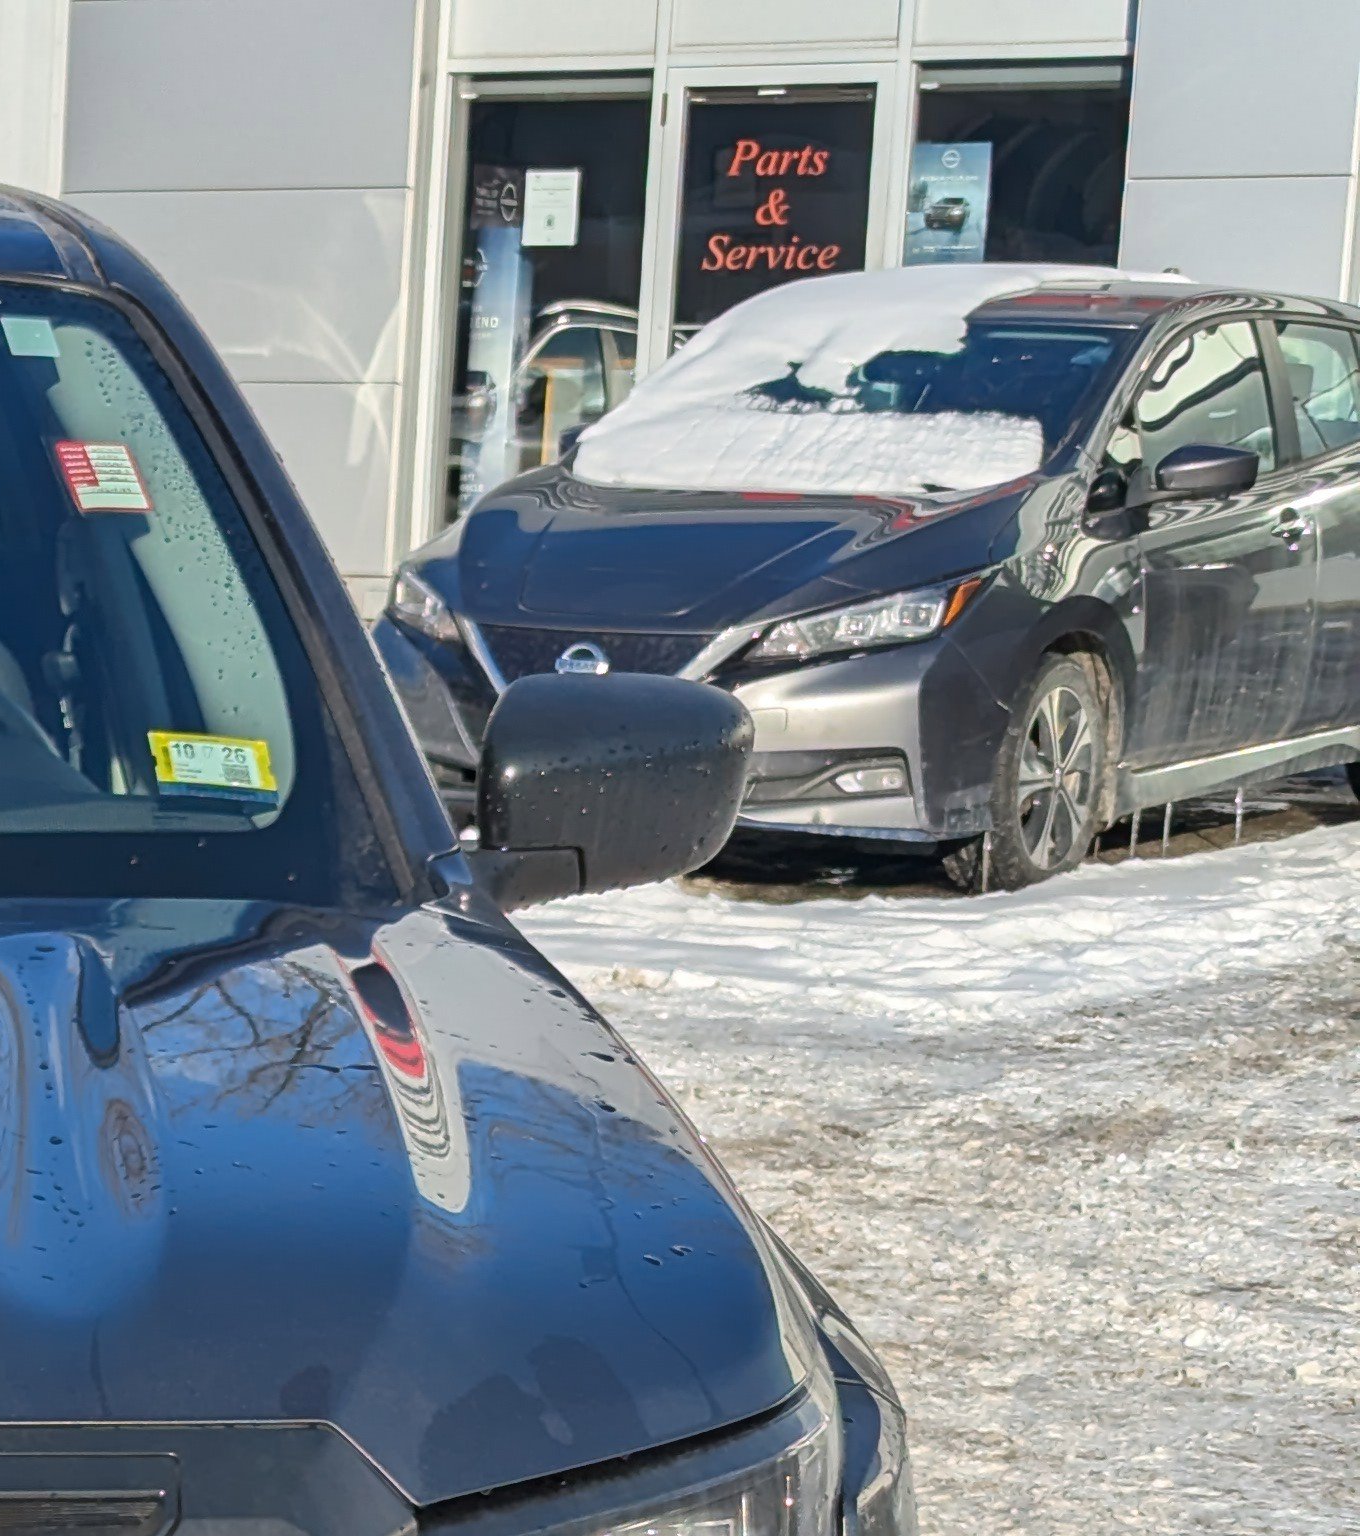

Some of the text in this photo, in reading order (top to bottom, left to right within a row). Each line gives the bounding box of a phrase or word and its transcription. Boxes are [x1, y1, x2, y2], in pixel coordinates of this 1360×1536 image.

[727, 138, 830, 177] Parts
[755, 188, 791, 226] &
[701, 233, 840, 271] Service
